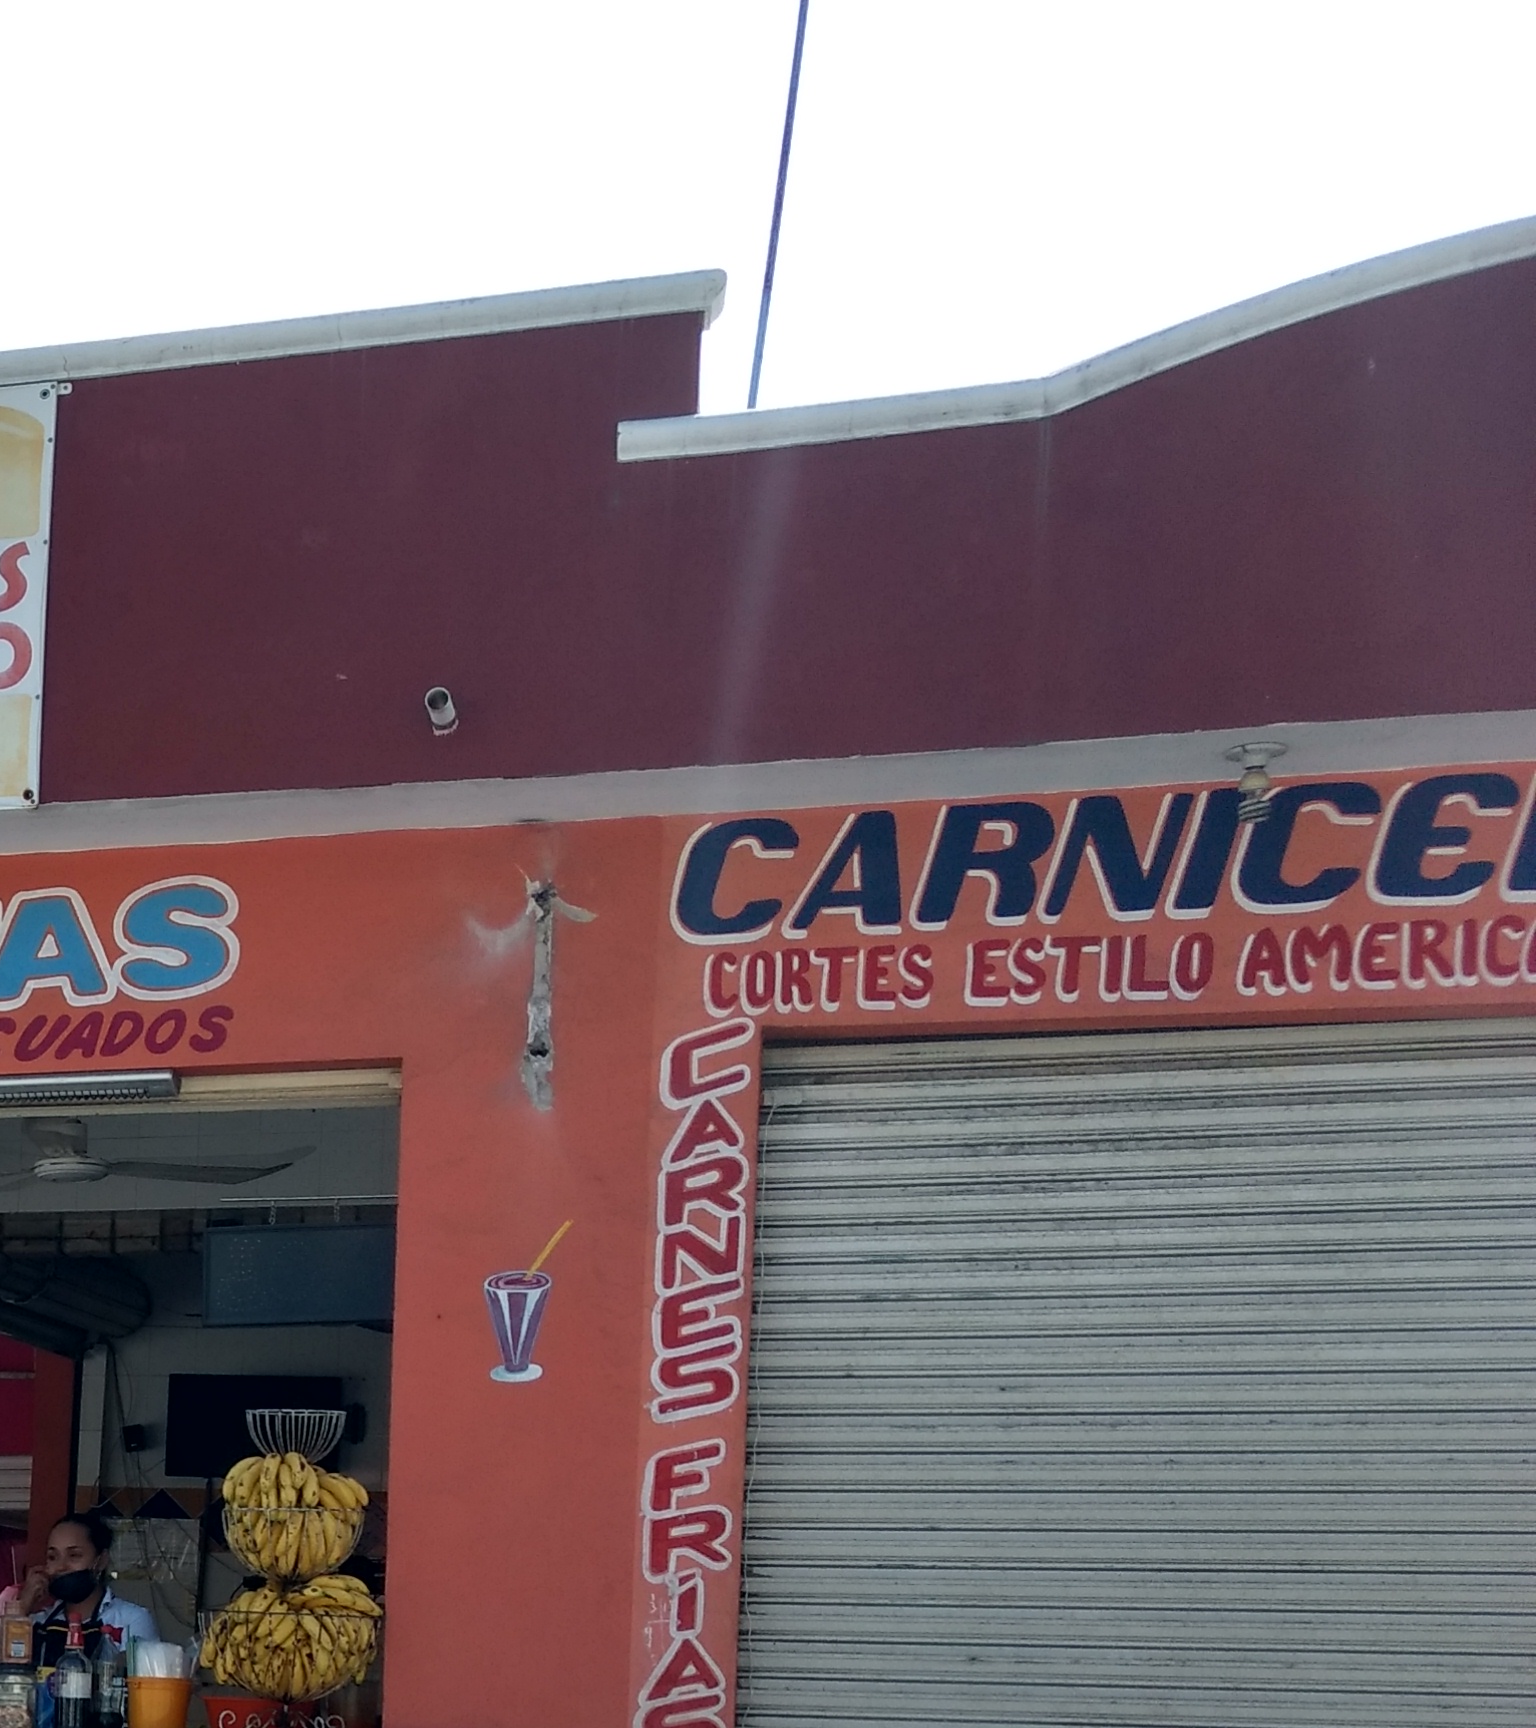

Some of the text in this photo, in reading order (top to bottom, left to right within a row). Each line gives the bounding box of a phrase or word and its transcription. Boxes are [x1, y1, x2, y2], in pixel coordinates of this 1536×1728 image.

[670, 771, 1536, 946] CARNICE
[702, 942, 934, 1018] CORTES
[962, 929, 1216, 1009] ESTILO
[650, 1016, 756, 1424] CARNES
